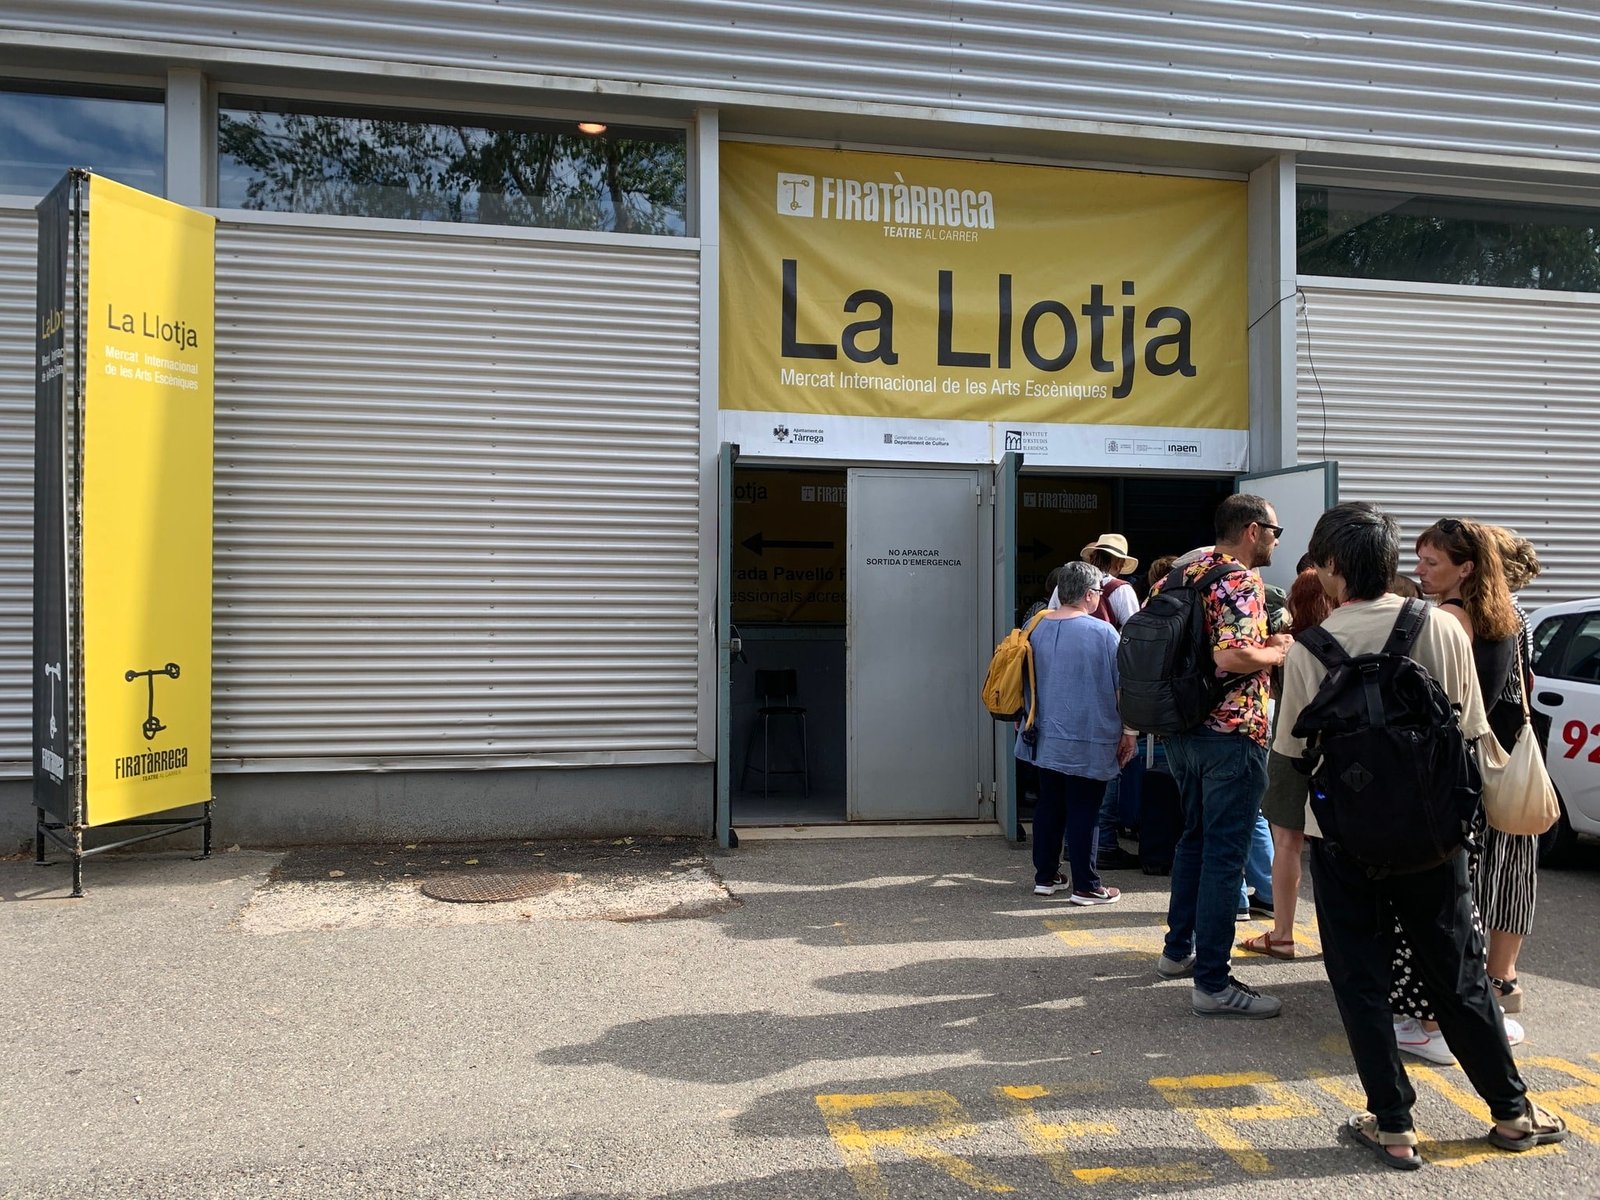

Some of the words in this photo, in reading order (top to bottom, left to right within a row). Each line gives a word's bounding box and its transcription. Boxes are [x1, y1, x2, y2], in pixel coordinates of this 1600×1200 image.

[883, 226, 922, 239] TEATRE
[924, 229, 937, 240] AL
[938, 230, 979, 242] CARRER
[107, 303, 135, 334] La
[142, 311, 198, 351] Llotja
[781, 259, 898, 365] La
[937, 270, 1197, 399] Llotja
[105, 345, 138, 363] Mercat
[144, 353, 198, 375] Internacional
[105, 363, 116, 375] de
[120, 365, 133, 378] les
[134, 367, 152, 383] Arts
[154, 371, 198, 391] Escèniques
[780, 368, 835, 388] Mercat
[839, 371, 937, 393] Internacional
[942, 377, 960, 394] de
[965, 378, 987, 395] les
[991, 379, 1020, 396] Arts
[1025, 380, 1107, 401] Escèniques
[793, 433, 824, 443] Tàrrega
[1168, 444, 1198, 453] inaem
[902, 549, 940, 557] APARCAR
[866, 558, 901, 566] SORTIDA
[773, 566, 834, 581] Pavelló
